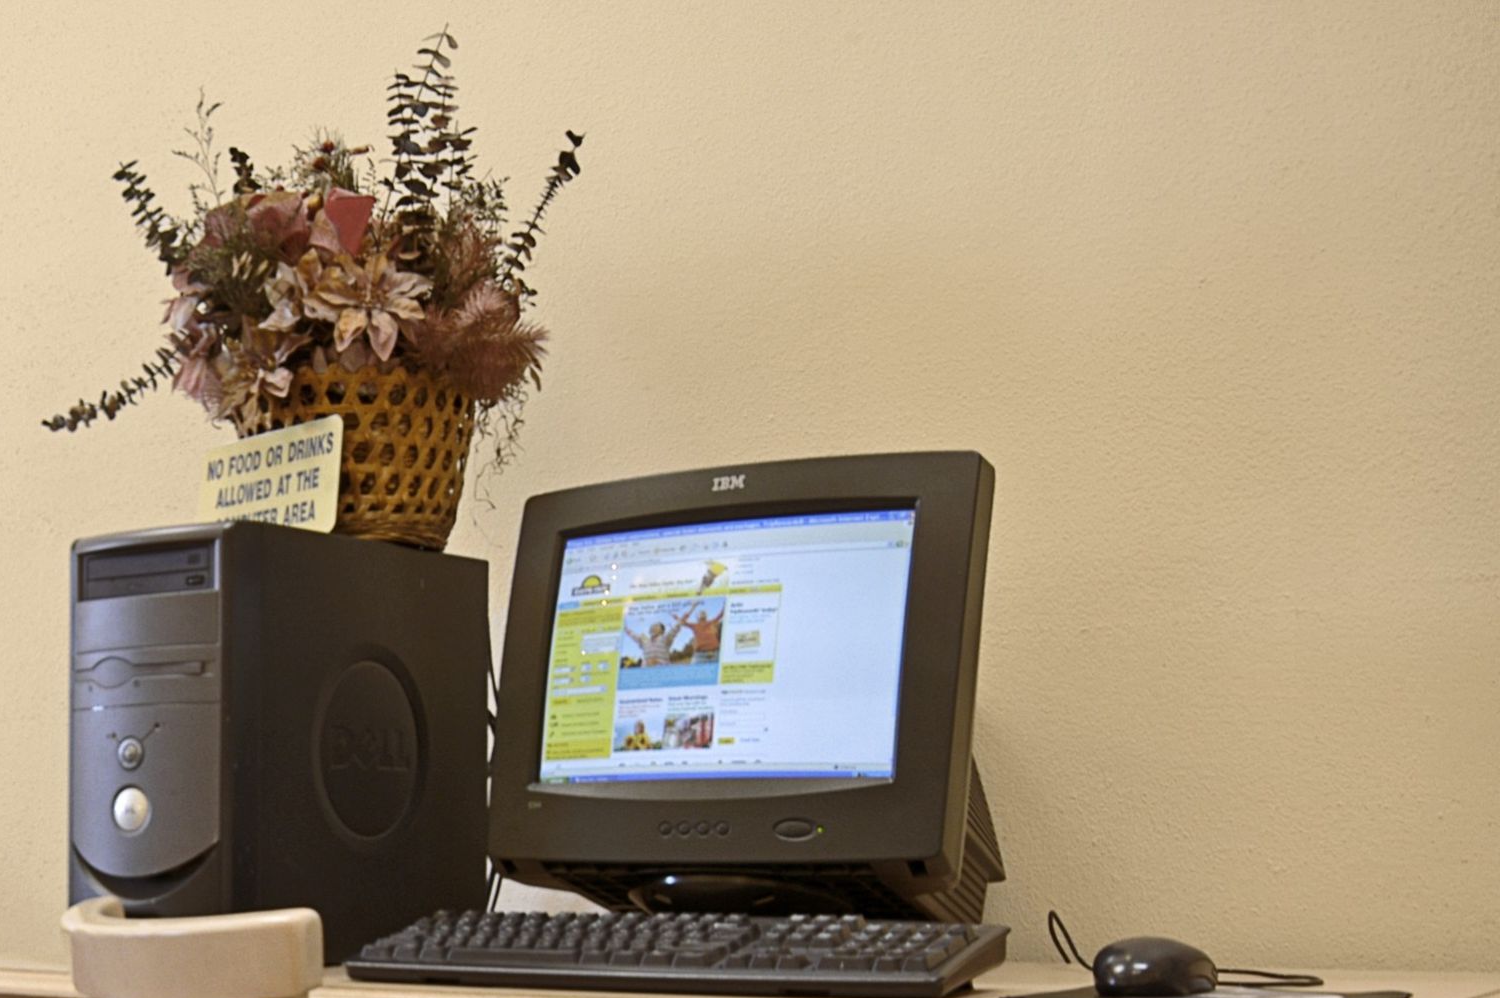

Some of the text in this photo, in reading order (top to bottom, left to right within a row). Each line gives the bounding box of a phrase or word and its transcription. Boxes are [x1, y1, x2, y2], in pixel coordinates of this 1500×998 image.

[207, 432, 335, 482] NO FOOD OR DRINKS
[215, 467, 320, 509] ALLOWED AT THE
[711, 474, 746, 492] IBM
[283, 499, 316, 527] AREA
